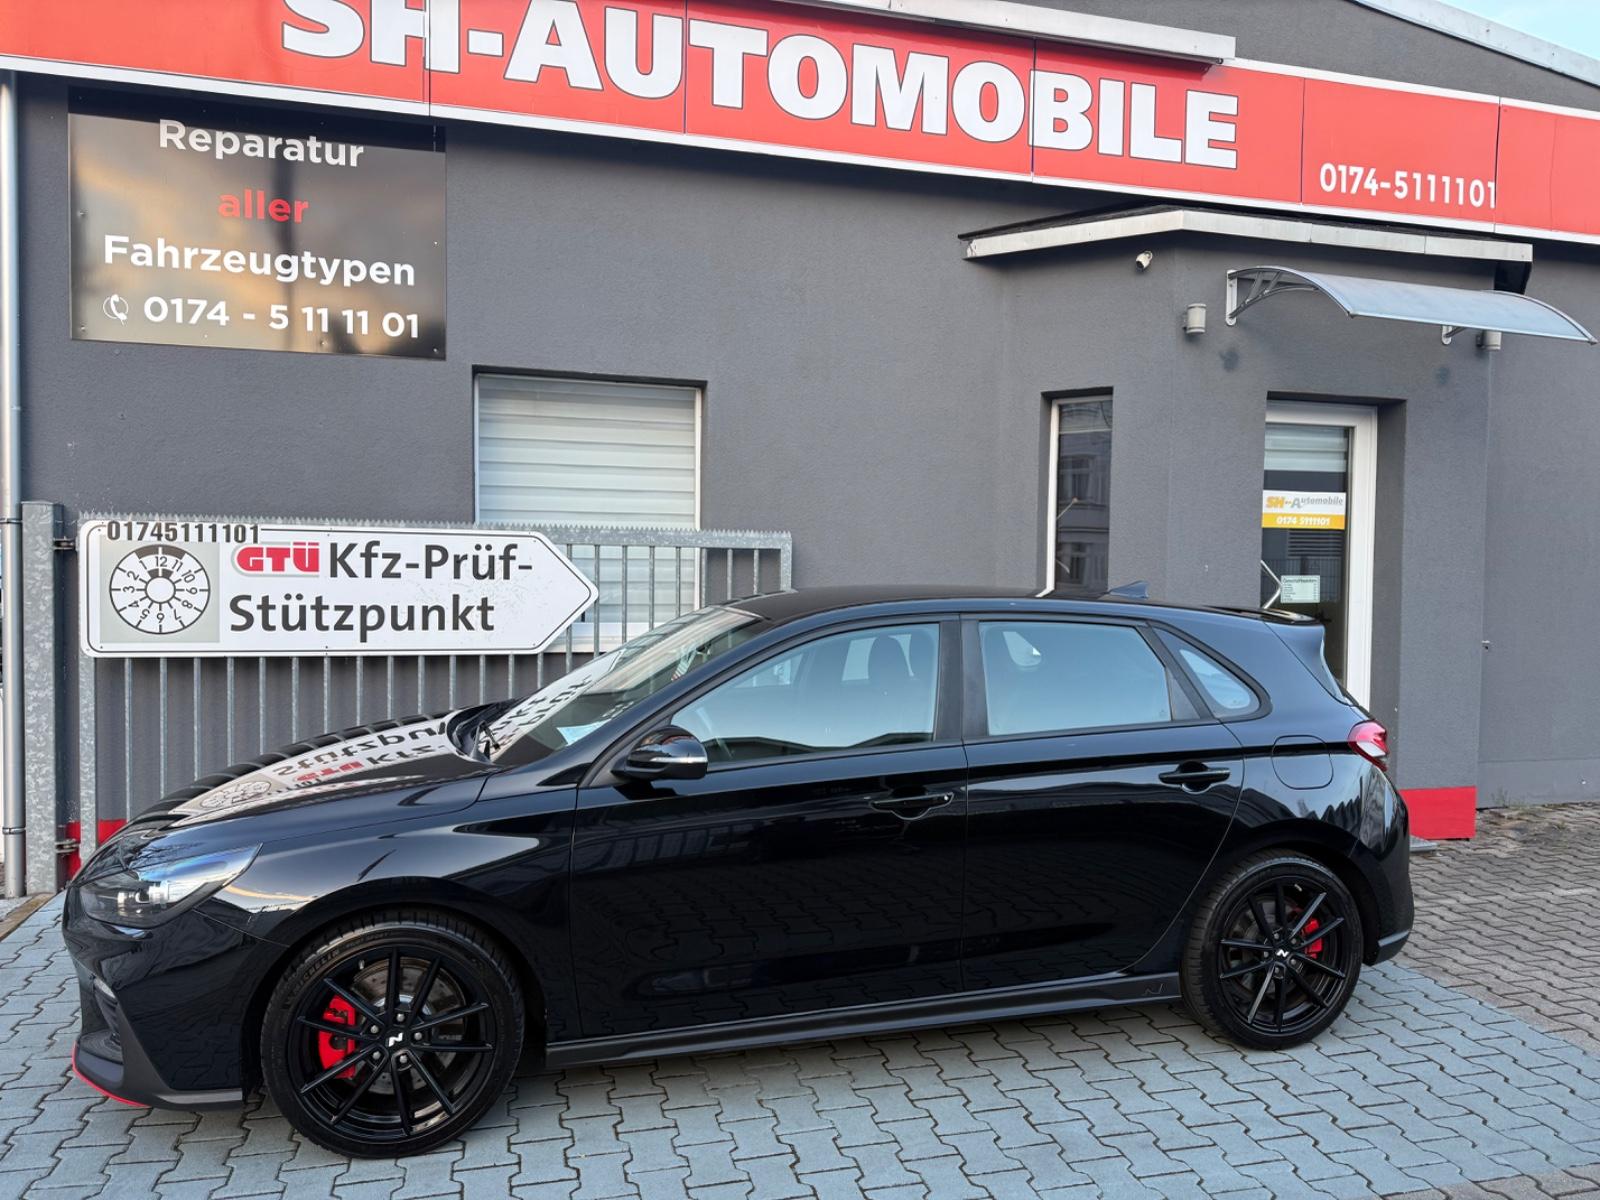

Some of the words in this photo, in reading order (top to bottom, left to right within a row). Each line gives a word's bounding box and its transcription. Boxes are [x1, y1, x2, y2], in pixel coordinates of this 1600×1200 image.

[281, 0, 1239, 170] SH-AUTOMOBILE
[158, 119, 365, 169] Reparatur
[217, 189, 310, 224] aller
[1319, 162, 1497, 210] 0174-5111101
[104, 234, 415, 287] Fahrzeugtypen
[143, 296, 230, 326] 0174
[269, 305, 289, 330] 5
[301, 306, 329, 333] 11
[341, 309, 369, 335] 11
[381, 312, 419, 339] 01
[107, 520, 259, 544] 01745111101
[236, 541, 320, 573] GTÜ
[329, 540, 533, 581] Kfz-Prüf-
[229, 593, 495, 643] Stützpunkt
